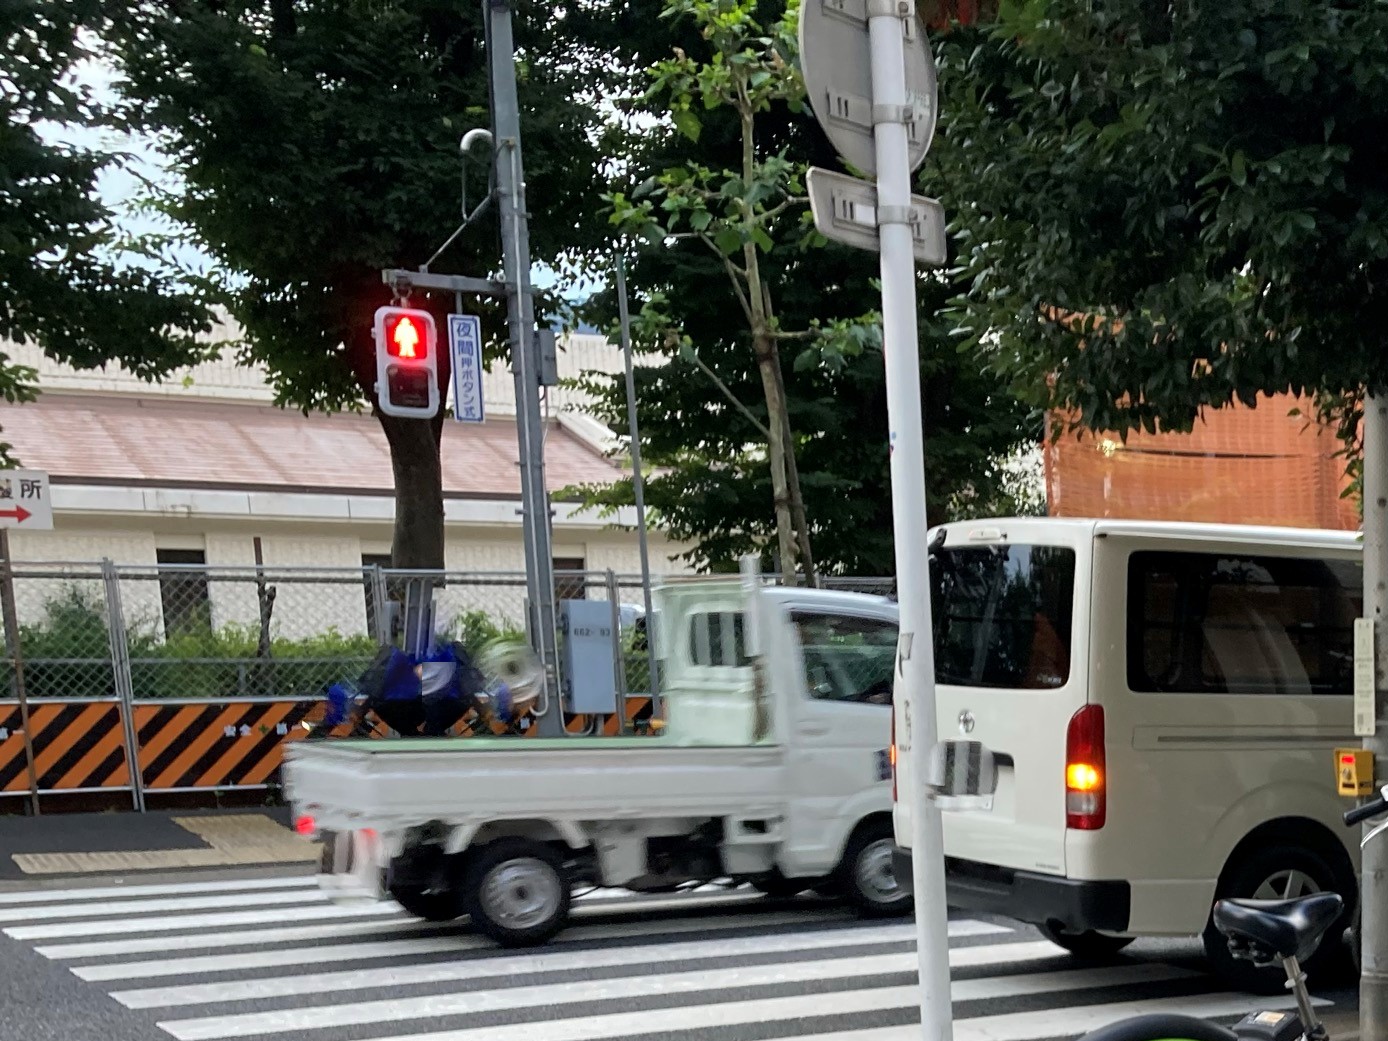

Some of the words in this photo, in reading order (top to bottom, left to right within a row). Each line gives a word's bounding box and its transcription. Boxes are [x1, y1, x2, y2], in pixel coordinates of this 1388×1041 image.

[456, 321, 476, 417] 夜間押ボタン式
